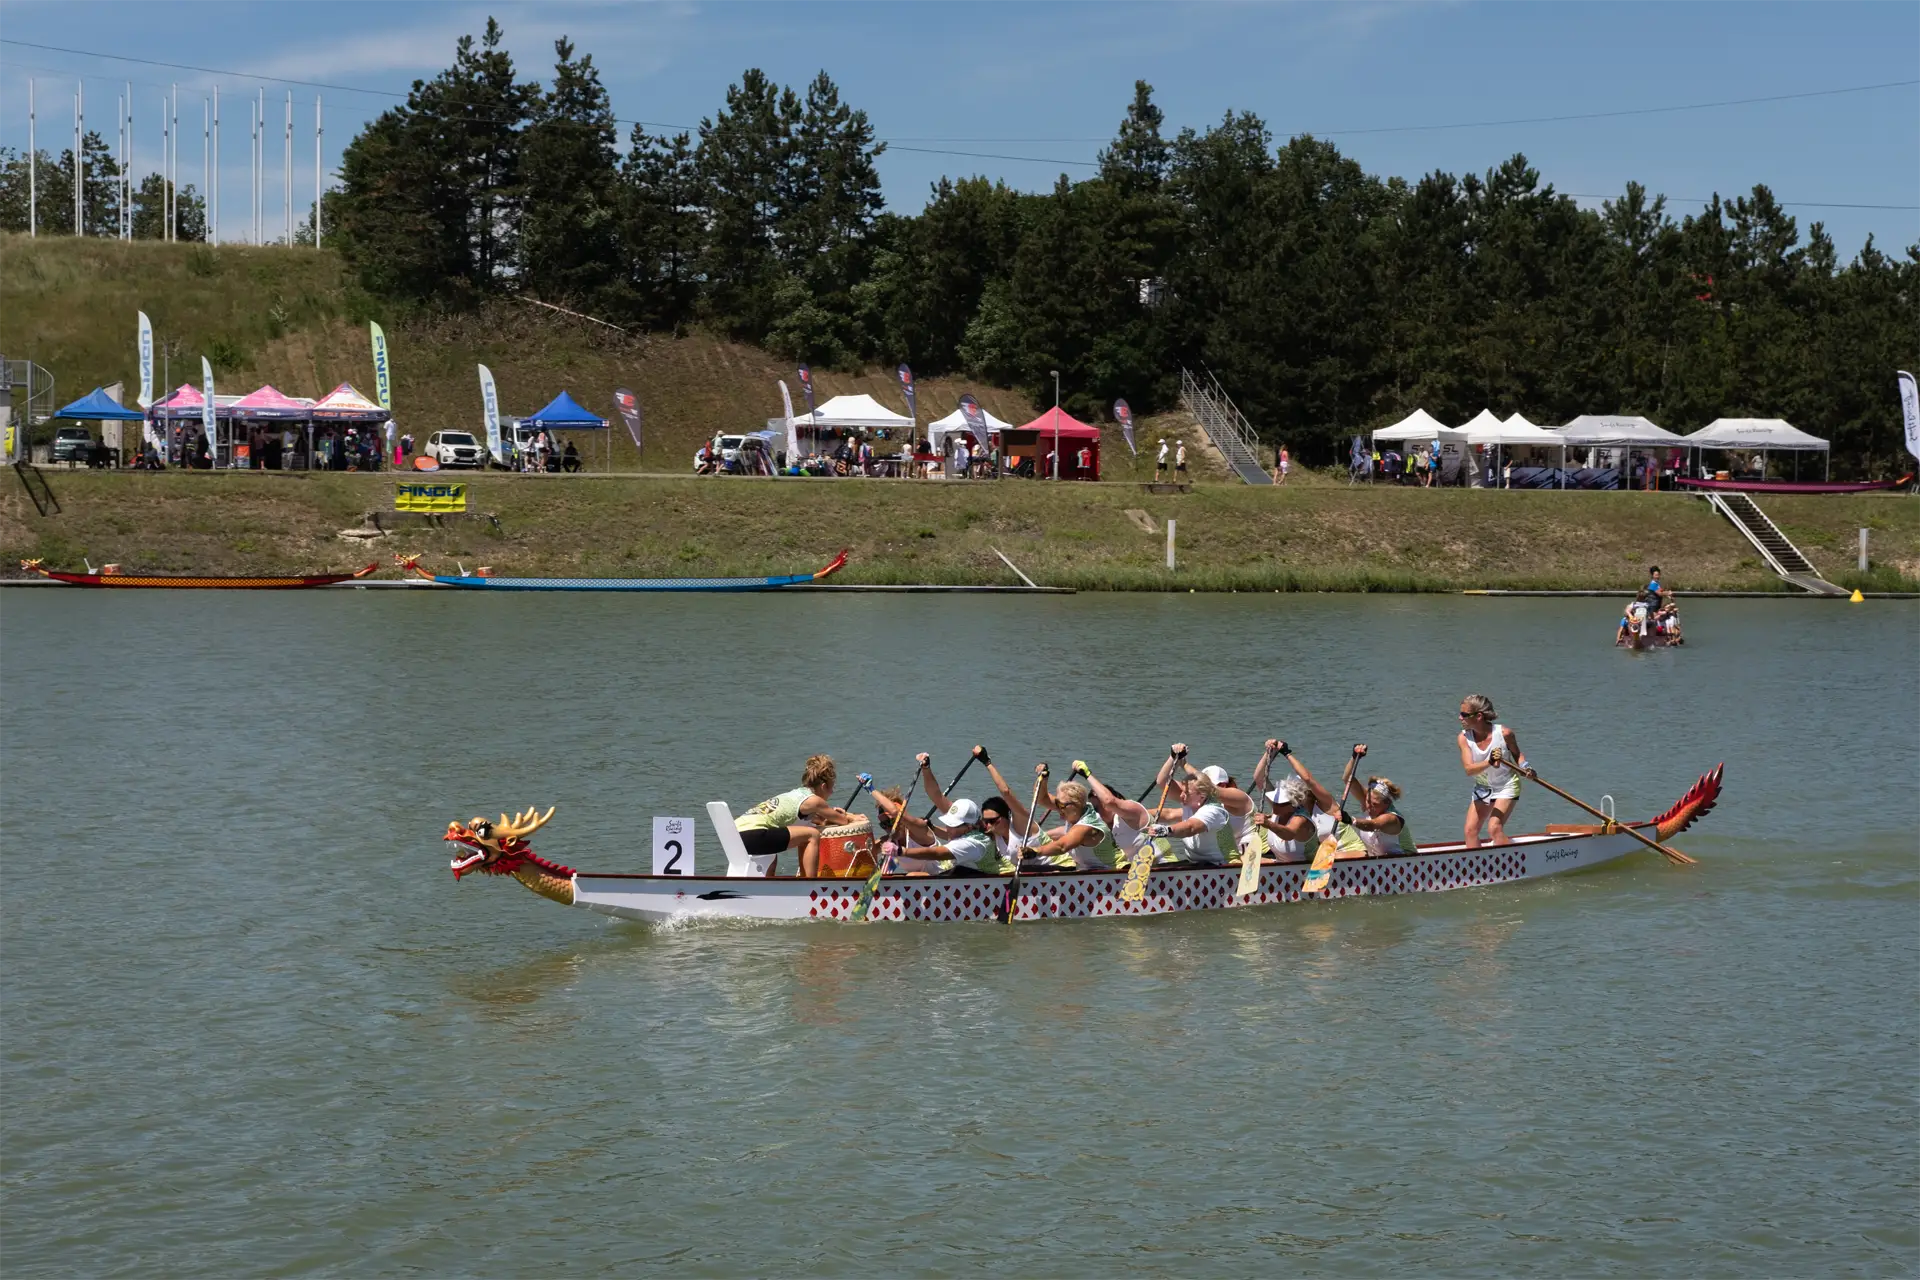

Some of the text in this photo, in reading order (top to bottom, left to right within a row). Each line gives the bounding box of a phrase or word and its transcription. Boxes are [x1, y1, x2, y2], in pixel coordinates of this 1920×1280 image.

[376, 335, 389, 403] PINGU
[399, 486, 461, 497] PINGU
[663, 840, 682, 875] 2
[1545, 850, 1560, 863] Swift
